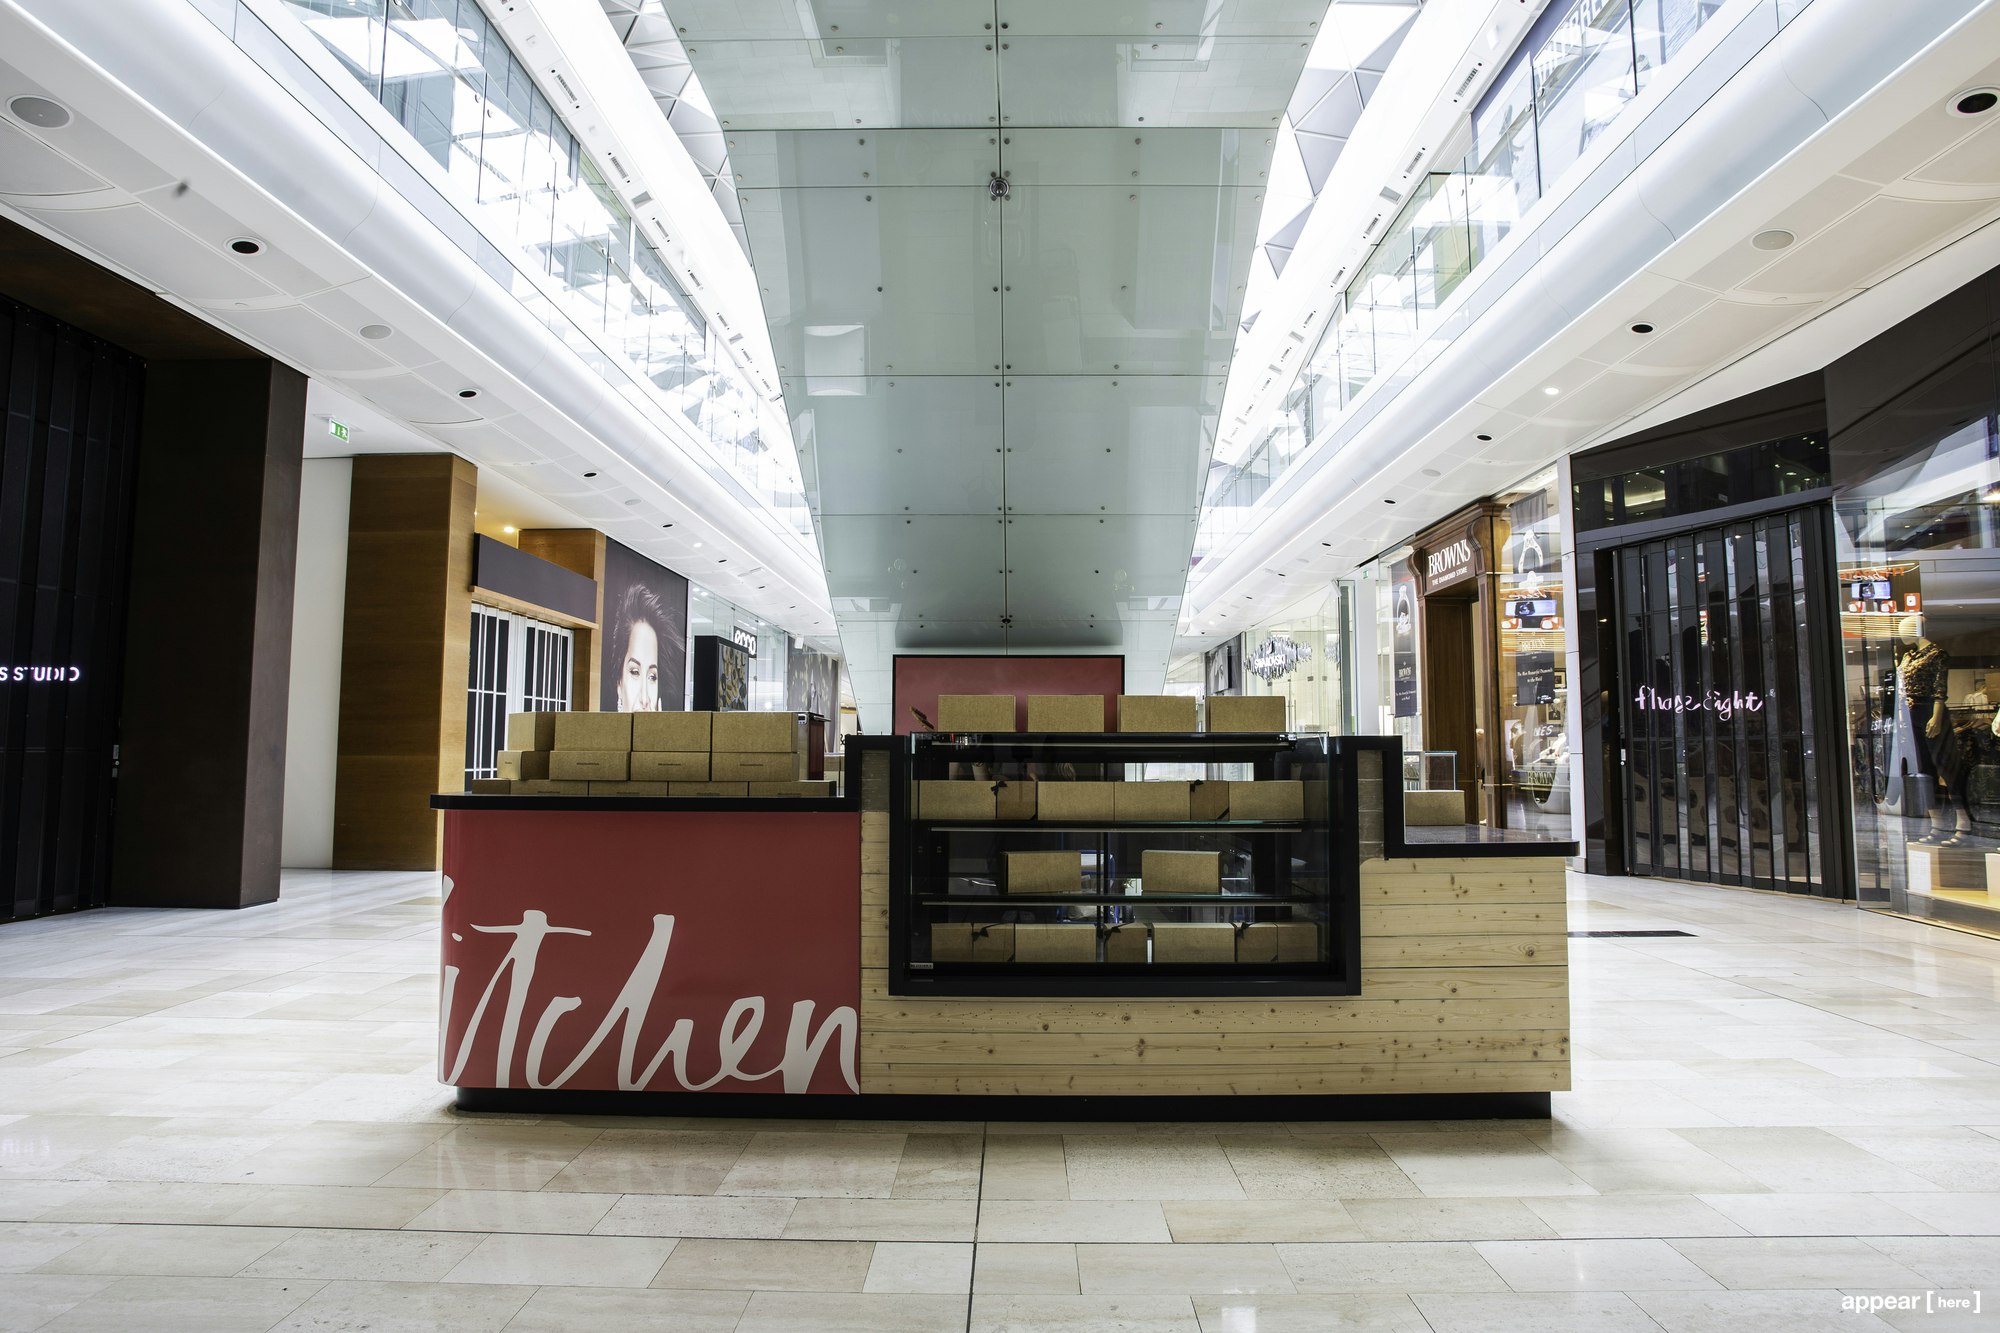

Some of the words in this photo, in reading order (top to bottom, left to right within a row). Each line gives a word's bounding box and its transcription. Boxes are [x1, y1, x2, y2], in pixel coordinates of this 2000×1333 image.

[1428, 539, 1471, 577] BROWNS
[1439, 571, 1456, 583] DIAMOND
[439, 875, 860, 1095] itchen
